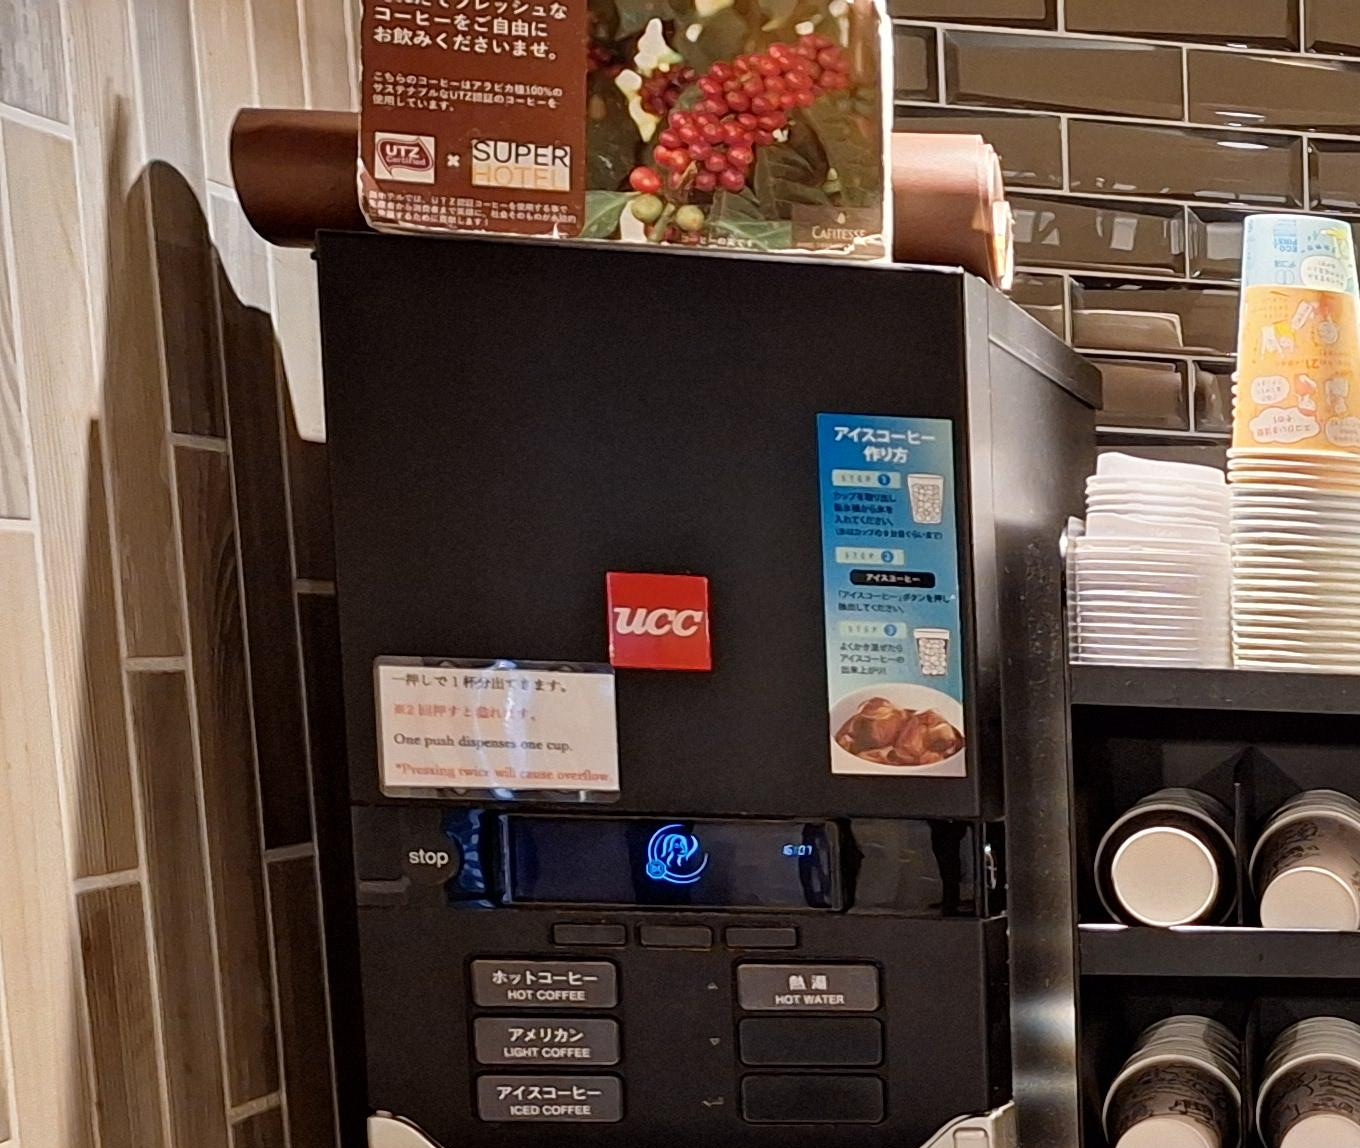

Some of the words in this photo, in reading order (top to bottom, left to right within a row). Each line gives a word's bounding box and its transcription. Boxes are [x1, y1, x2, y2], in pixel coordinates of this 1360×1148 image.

[374, 6, 548, 37] コーヒーをご自由に
[374, 26, 556, 60] お飲みくださいませ。
[386, 143, 420, 157] UTZ
[473, 140, 569, 167] SUPER
[474, 166, 568, 190] HOTEL
[834, 426, 936, 445] アイスコーヒー
[864, 446, 909, 464] 作り方
[394, 733, 421, 745] One
[425, 733, 455, 749] push
[458, 735, 516, 753] dispenses
[520, 740, 543, 750] one
[408, 847, 449, 867] stop
[492, 970, 598, 985] ホットコーヒー
[508, 990, 533, 1000] HOT
[536, 990, 585, 1001] COFFEE
[775, 994, 801, 1005] HOT
[803, 994, 845, 1005] WATER
[508, 1028, 584, 1042] アメリカン
[504, 1047, 539, 1057] LIGHT
[541, 1047, 591, 1058] COFFEE
[496, 1085, 602, 1100] アイスコーヒー
[510, 1105, 539, 1115] ICED
[542, 1105, 591, 1115] COFFEE
